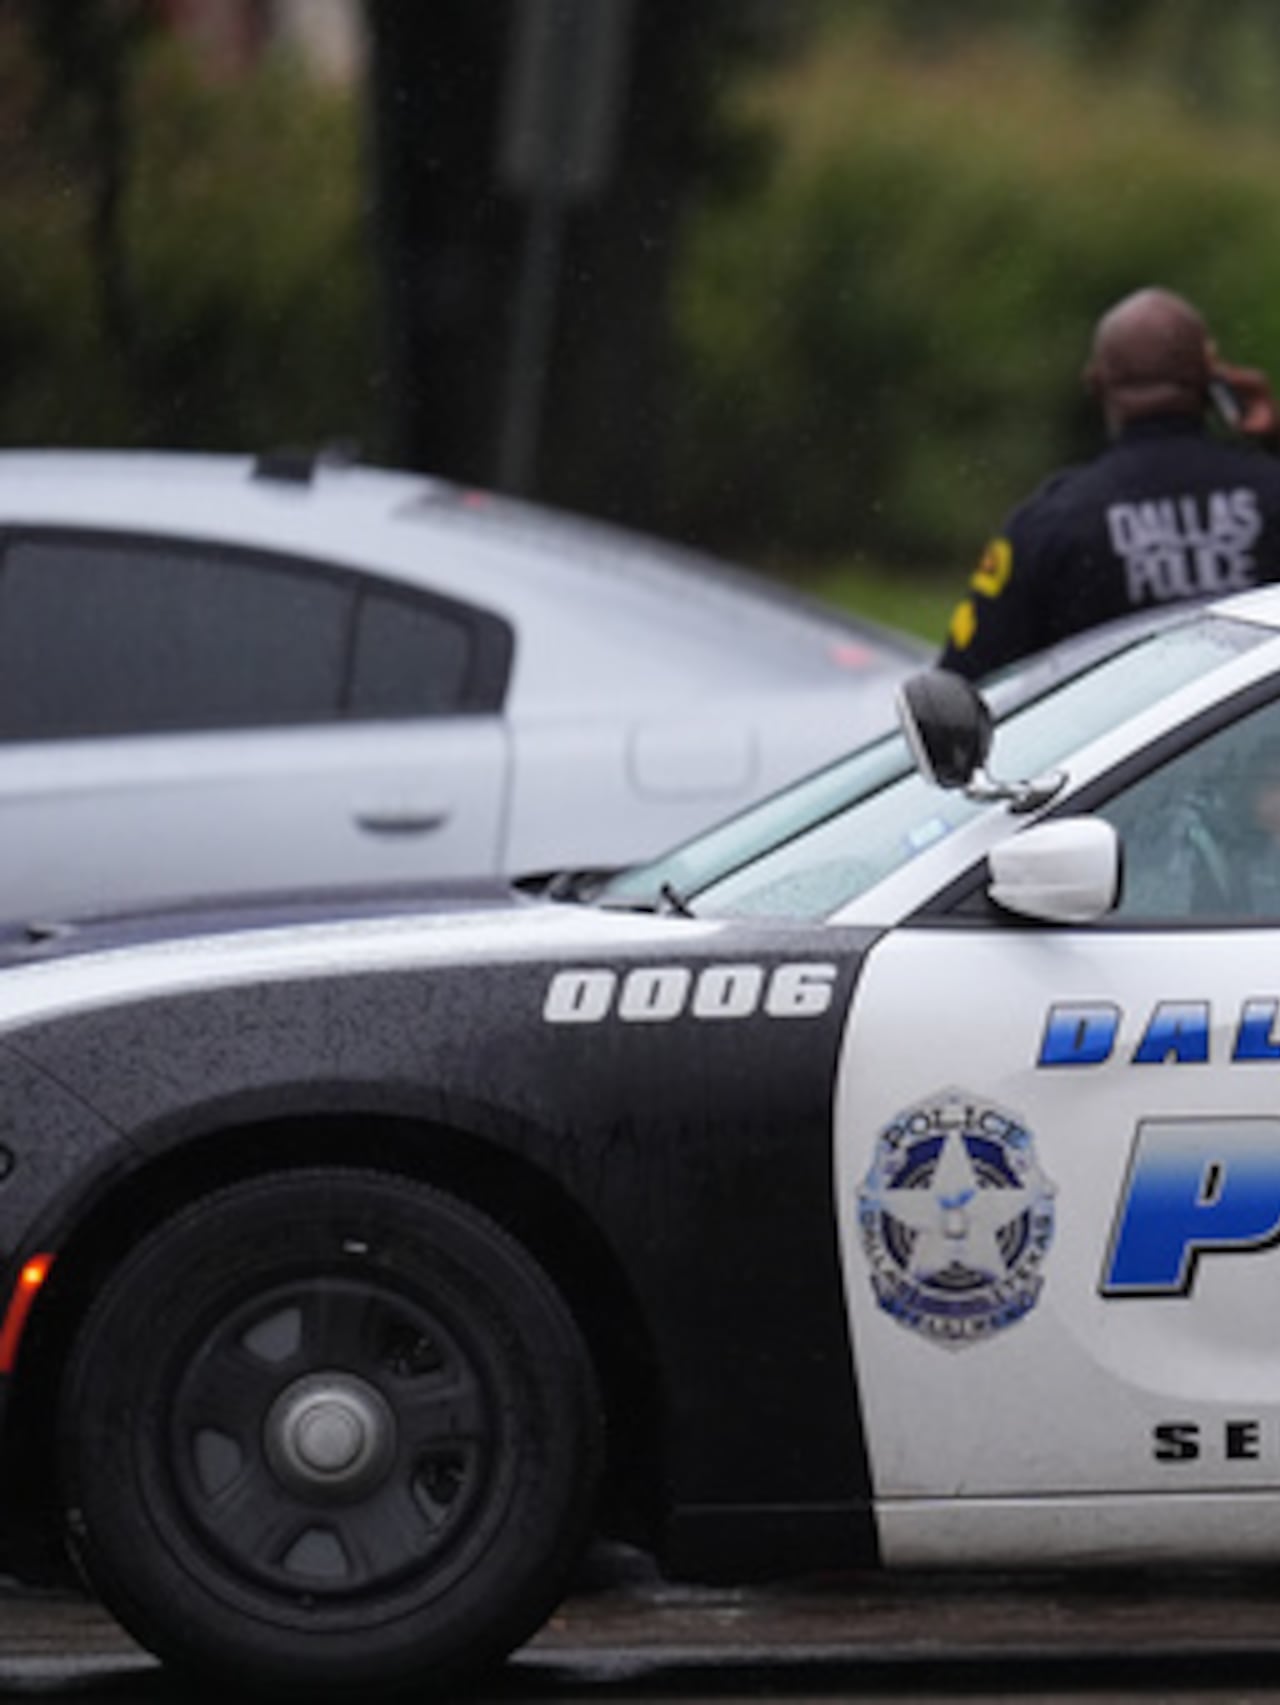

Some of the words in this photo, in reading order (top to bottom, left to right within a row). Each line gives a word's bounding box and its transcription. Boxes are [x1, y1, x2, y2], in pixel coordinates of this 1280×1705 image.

[1106, 487, 1263, 557] DALLAS
[1123, 545, 1258, 605] POLICE
[542, 962, 838, 1023] 0006
[883, 1105, 1031, 1150] POLICE
